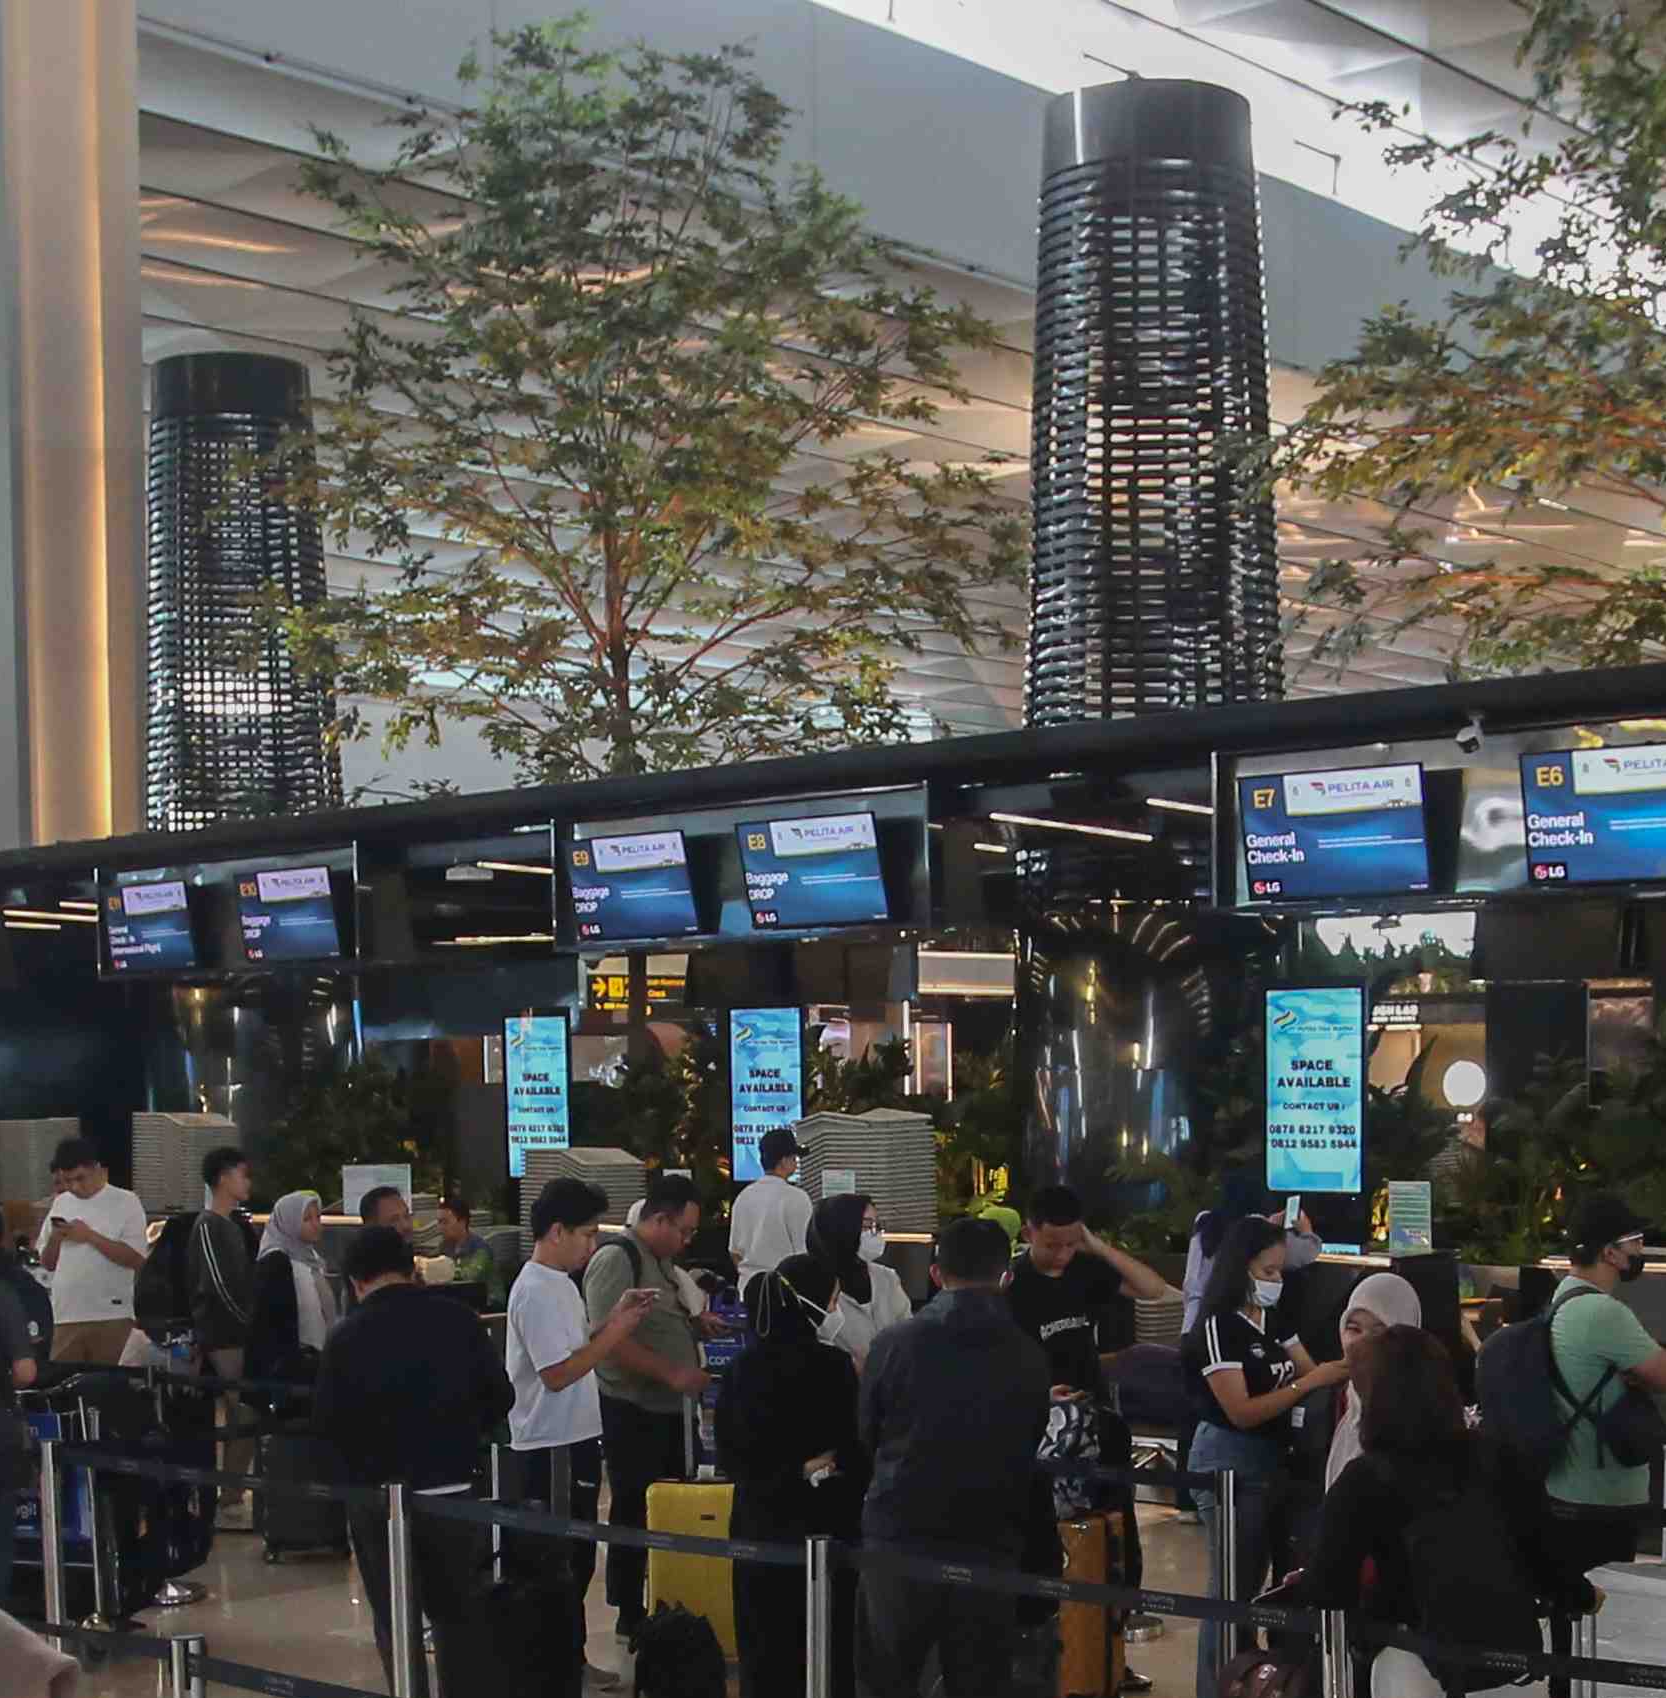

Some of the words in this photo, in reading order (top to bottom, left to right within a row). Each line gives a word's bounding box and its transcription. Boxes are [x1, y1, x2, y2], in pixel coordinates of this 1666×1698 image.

[1536, 766, 1564, 787] E6
[1327, 781, 1372, 793] PELITA
[1373, 779, 1395, 789] AIR
[1253, 788, 1275, 808] E7
[1527, 811, 1585, 830] General
[1245, 832, 1296, 848] General
[1527, 830, 1594, 847] Check-In
[1247, 848, 1304, 865] Check-In
[1548, 865, 1565, 877] LG
[745, 871, 788, 886] Baggage
[572, 886, 610, 900] Baggage
[1266, 881, 1280, 893] LG
[748, 888, 774, 900] DROP
[764, 912, 777, 922] LG
[589, 925, 601, 934] LG
[1290, 1059, 1333, 1071] SPACE
[749, 1068, 781, 1079] SPACE
[739, 1082, 793, 1094] AVAILABLE
[1277, 1076, 1351, 1088] AVAILABLE
[1283, 1102, 1324, 1111] CONTACT
[1327, 1102, 1340, 1111] US
